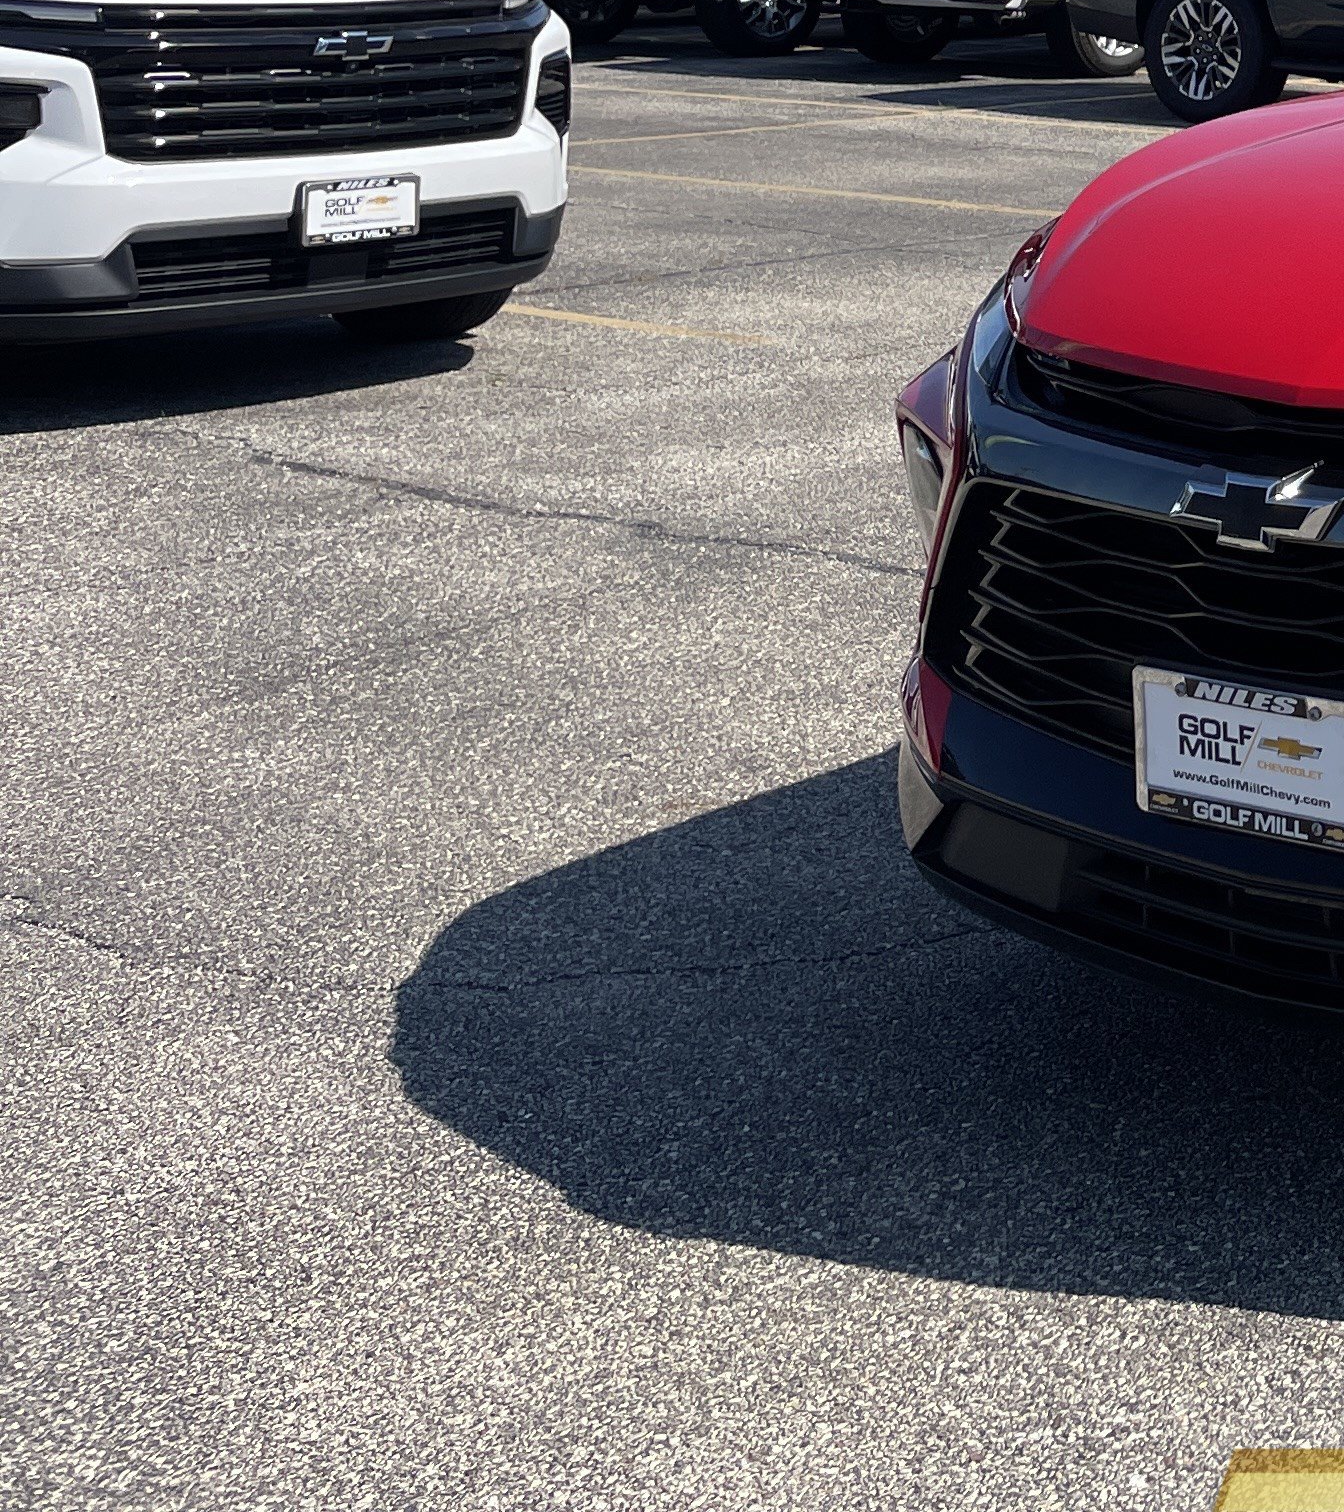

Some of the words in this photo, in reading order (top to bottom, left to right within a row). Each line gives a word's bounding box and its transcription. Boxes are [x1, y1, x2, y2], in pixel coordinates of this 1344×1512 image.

[324, 206, 357, 218] MILL
[325, 195, 366, 209] GOLF
[331, 231, 362, 243] GOLF
[1194, 680, 1298, 716] NILES
[1178, 712, 1256, 746] GOLF
[1178, 733, 1243, 766] MILL
[1256, 759, 1324, 781] CHEVROLET
[1173, 768, 1331, 809] www.GolfMillChevy.com
[1192, 799, 1251, 828] GOLF
[1253, 811, 1309, 841] MILL
